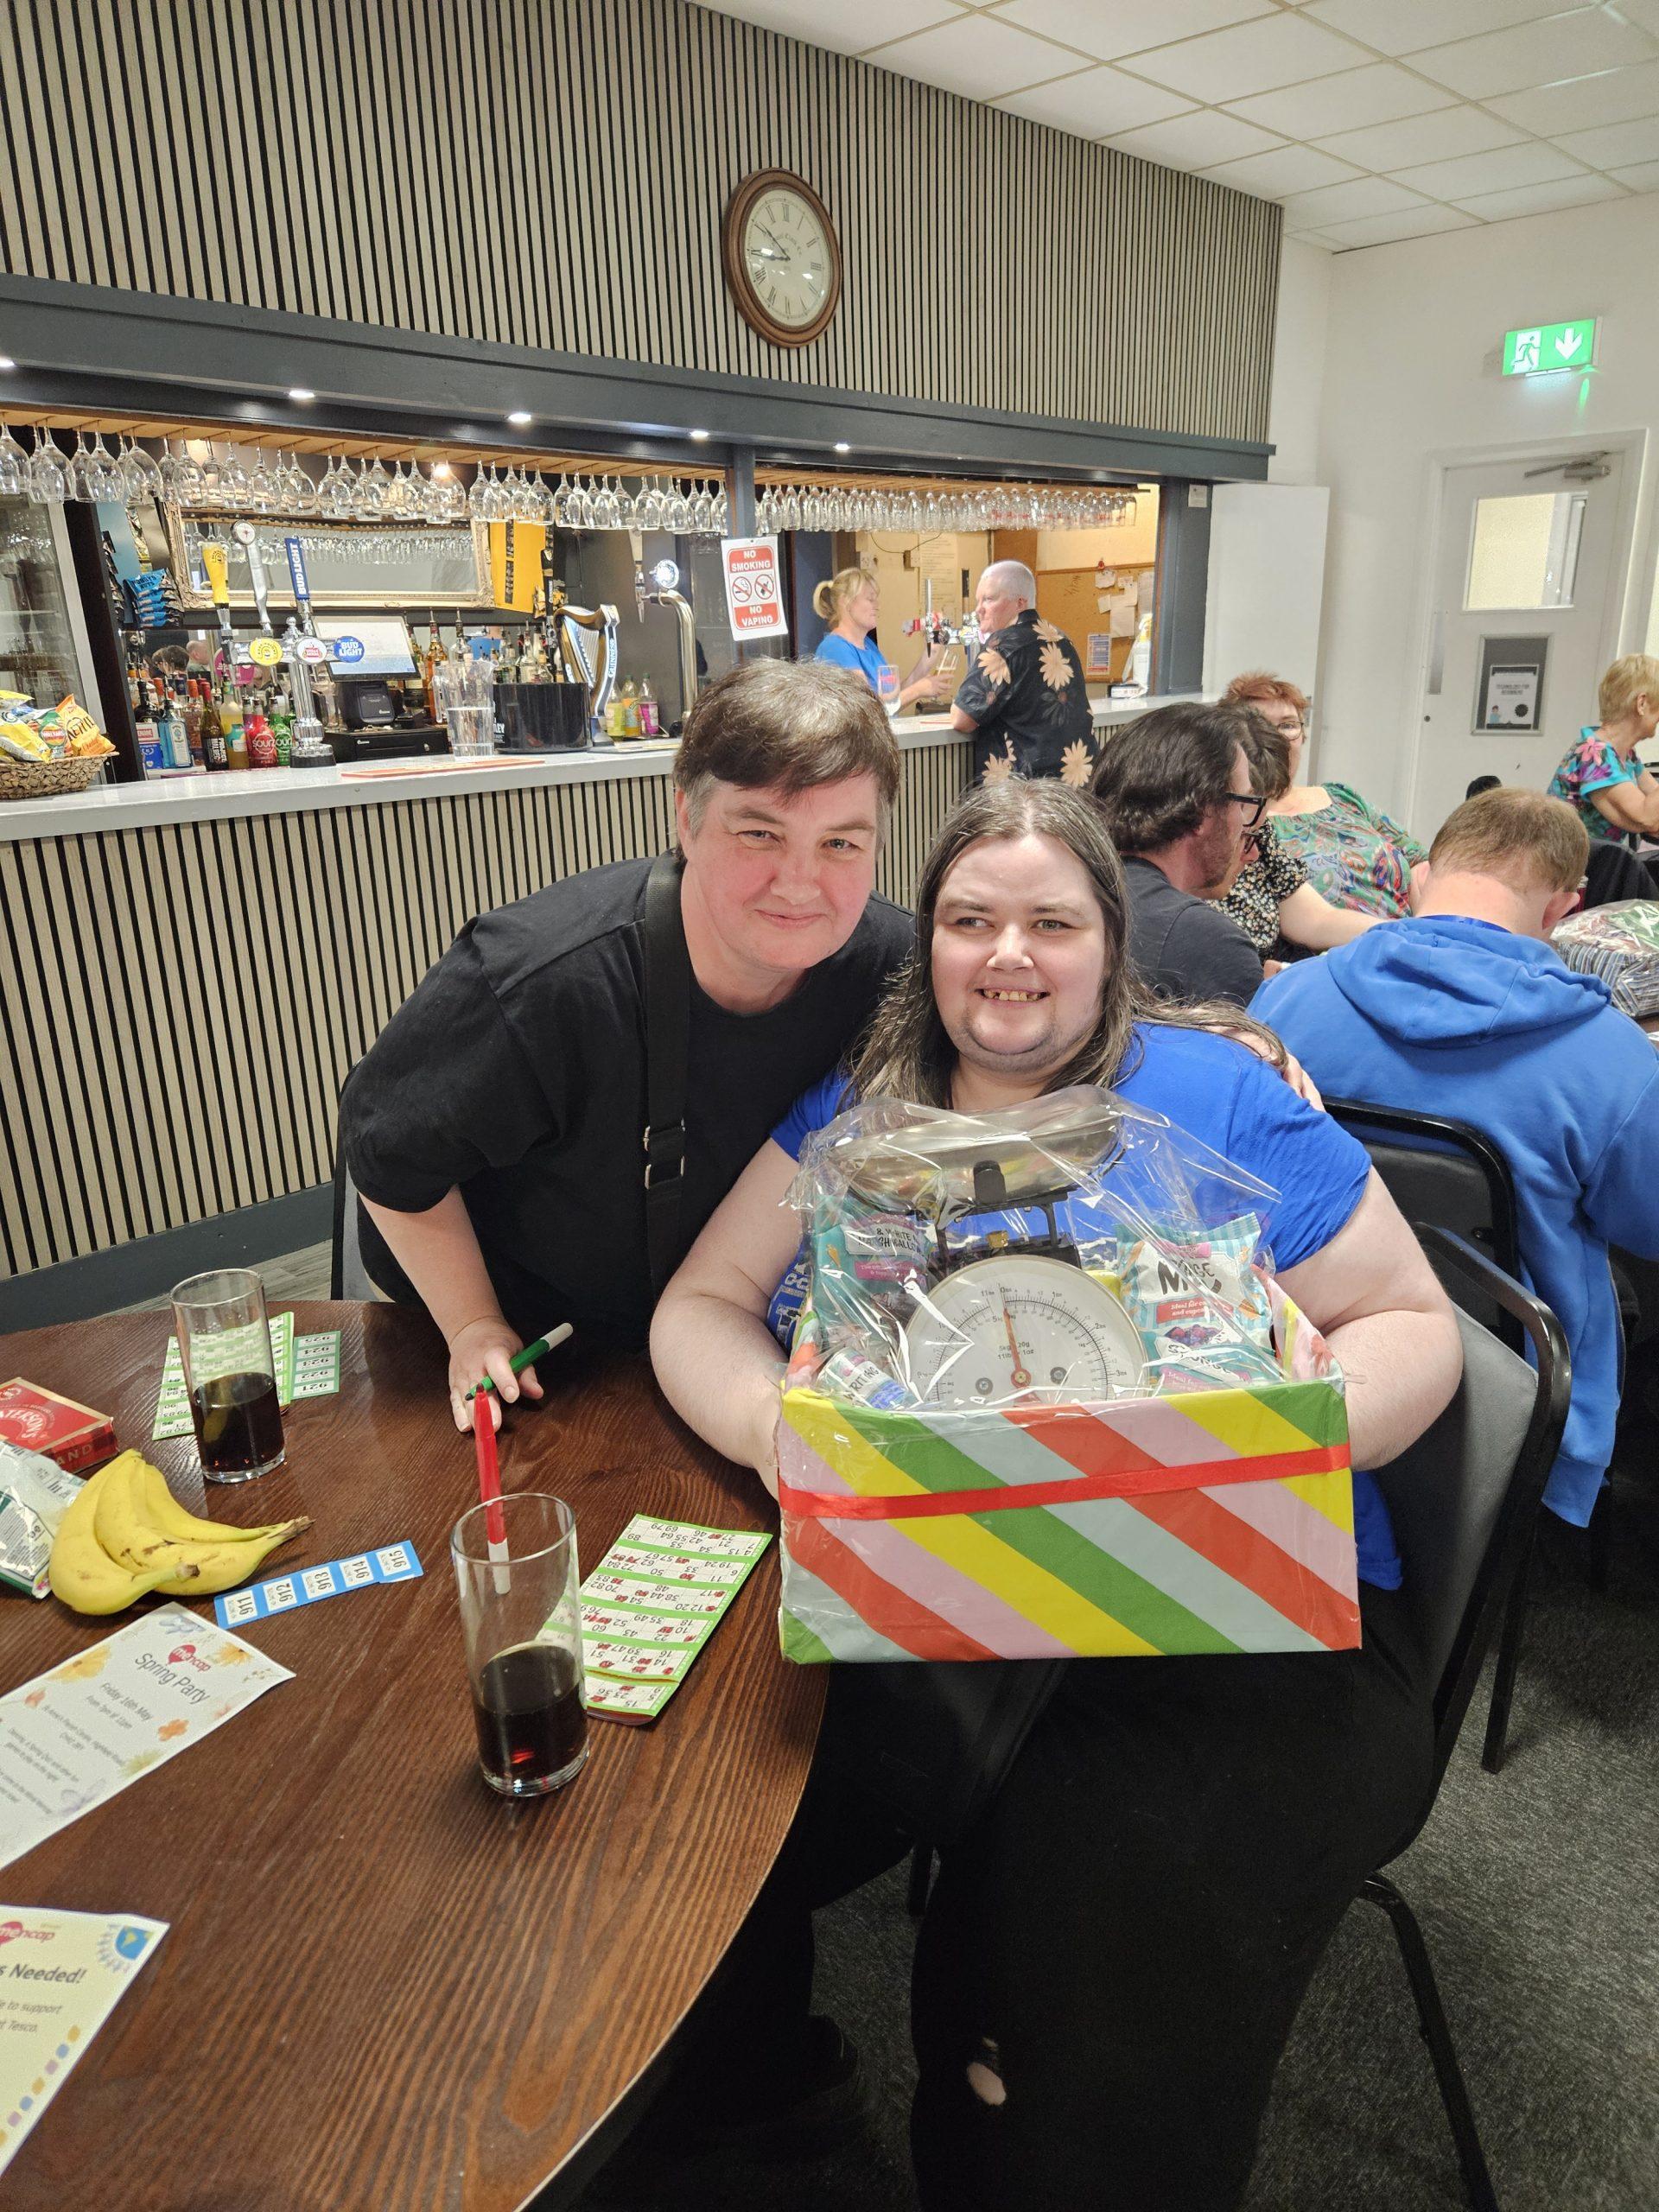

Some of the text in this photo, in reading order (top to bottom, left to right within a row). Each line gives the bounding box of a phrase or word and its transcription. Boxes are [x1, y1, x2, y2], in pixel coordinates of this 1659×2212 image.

[743, 550, 756, 559] NO
[289, 543, 307, 594] BUD LIGHT
[732, 560, 771, 572] SMOKING
[749, 606, 762, 614] NO
[741, 615, 773, 626] VAPING
[339, 648, 362, 657] LIGHT
[607, 639, 616, 678] GUINNESS
[57, 1445, 92, 1465] AND
[390, 1550, 407, 1568] 915
[353, 1560, 370, 1580] 914
[315, 1572, 333, 1591] 913
[276, 1582, 294, 1602] 912
[237, 1596, 254, 1616] 911
[588, 1606, 602, 1615] 76
[592, 1624, 607, 1632] 60
[613, 1618, 628, 1627] 52
[173, 1647, 212, 1673] mencap
[135, 1653, 210, 1705] Spring Party
[101, 1682, 122, 1700] Friday
[135, 1707, 153, 1721] May
[9, 1963, 88, 1984] Needed!
[7, 2001, 19, 2010] to
[19, 2003, 64, 2015] support
